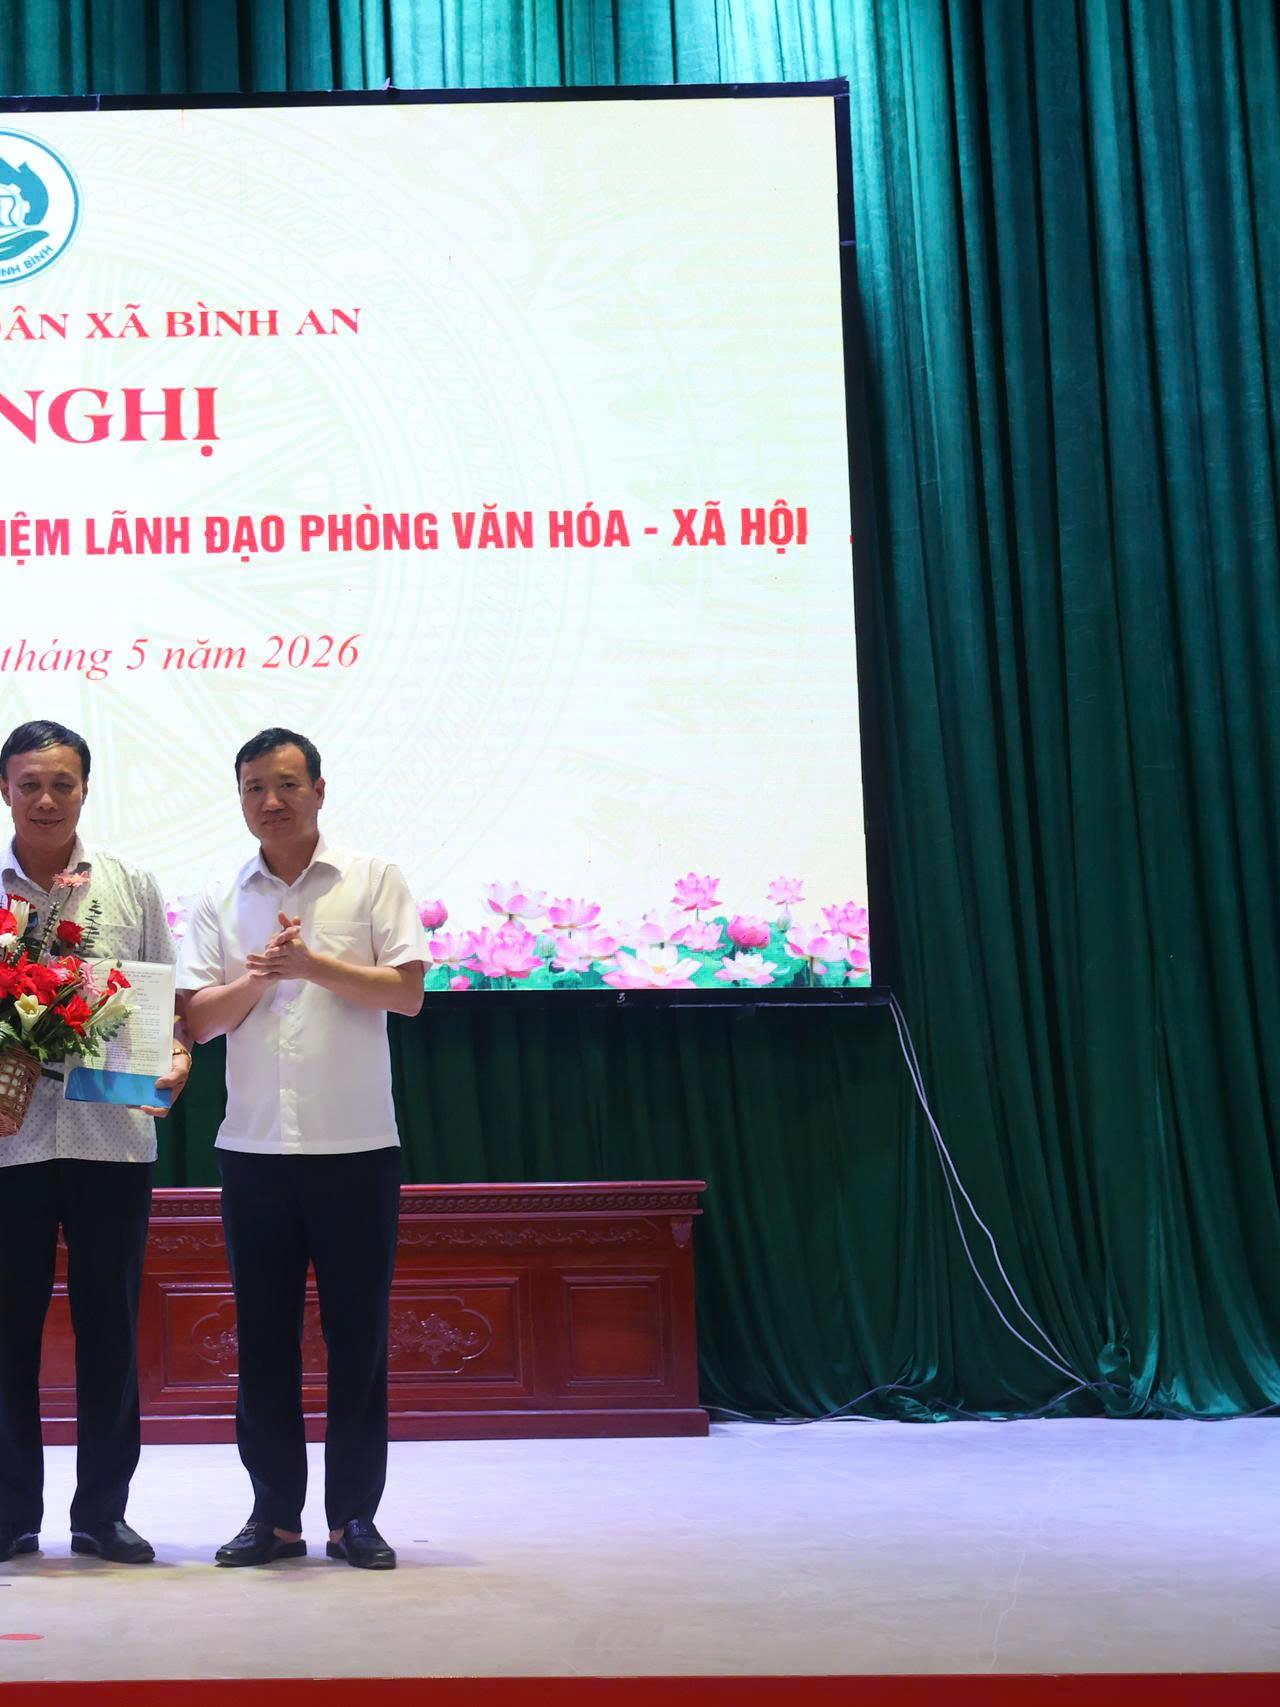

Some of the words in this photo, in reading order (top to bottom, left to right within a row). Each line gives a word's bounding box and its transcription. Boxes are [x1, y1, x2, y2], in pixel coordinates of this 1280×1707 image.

[23, 245, 53, 270] BÌNH
[86, 302, 150, 340] XÃ
[165, 301, 280, 338] BÌNH
[295, 307, 361, 336] AN
[85, 509, 191, 556] LÃNH
[203, 514, 285, 564] ĐẠO
[299, 503, 439, 553] PHÒNG
[451, 502, 535, 550] VĂN
[548, 501, 631, 549] HÓA
[643, 526, 659, 535] -
[671, 500, 727, 547] XÃ
[739, 498, 809, 555] HỘI
[0, 638, 113, 681] tháng
[126, 638, 149, 671] 5
[162, 638, 247, 670] năm
[261, 634, 363, 670] 2026
